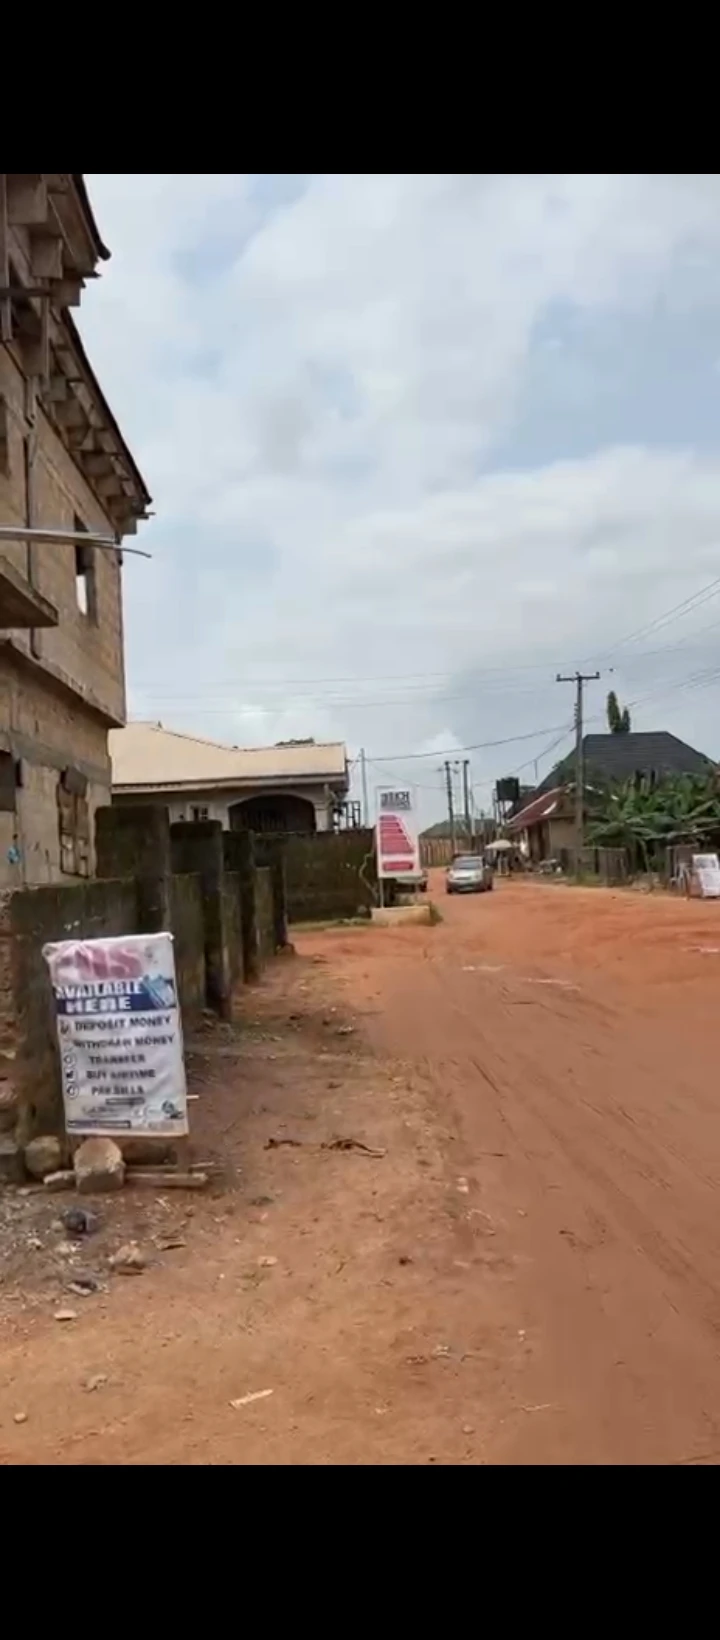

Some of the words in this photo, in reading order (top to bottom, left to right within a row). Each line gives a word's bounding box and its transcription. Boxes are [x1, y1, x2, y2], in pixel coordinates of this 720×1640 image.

[55, 980, 143, 999] AVAILABLE
[65, 996, 132, 1013] HERE
[74, 1018, 126, 1031] DEPOSIT
[129, 1015, 172, 1028] MONEY
[134, 1034, 175, 1046] MONEY
[89, 1054, 146, 1065] TRANSFER
[86, 1070, 107, 1080] BUY
